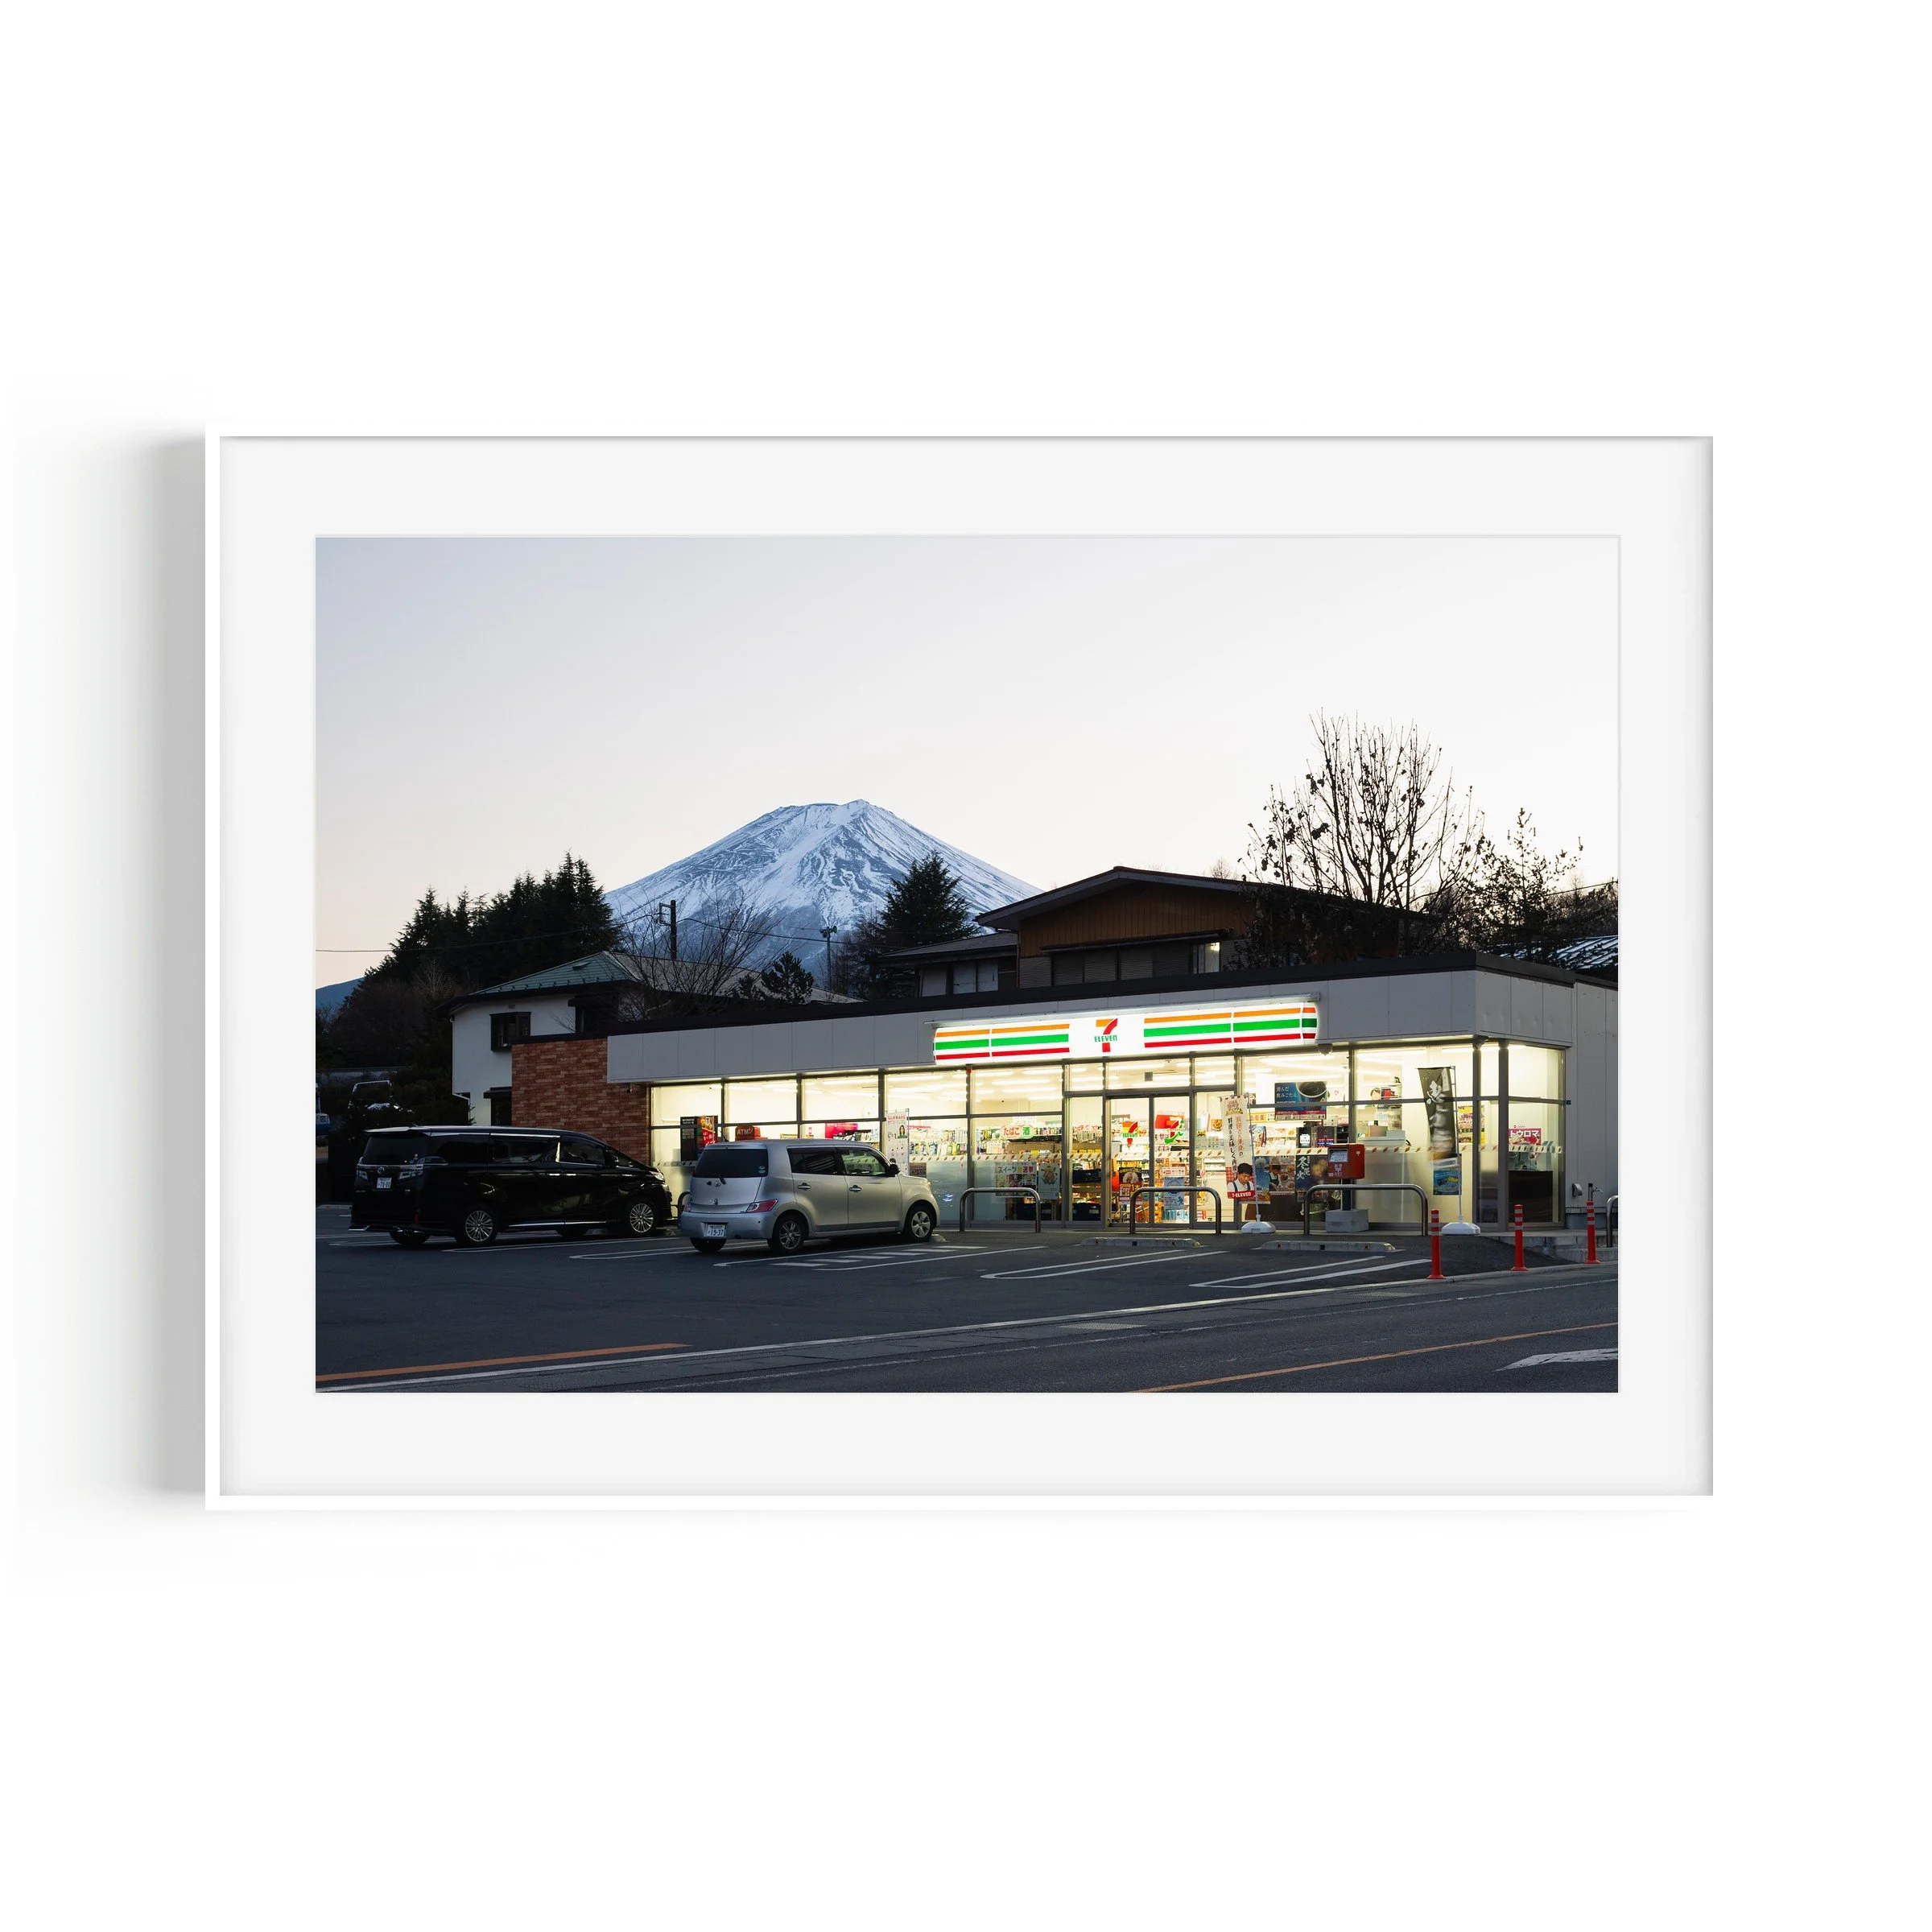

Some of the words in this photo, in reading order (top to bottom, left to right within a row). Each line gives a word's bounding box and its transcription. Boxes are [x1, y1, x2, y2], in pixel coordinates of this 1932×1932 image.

[1096, 1018, 1118, 1052] 7
[1003, 1127, 1020, 1136] たばこ
